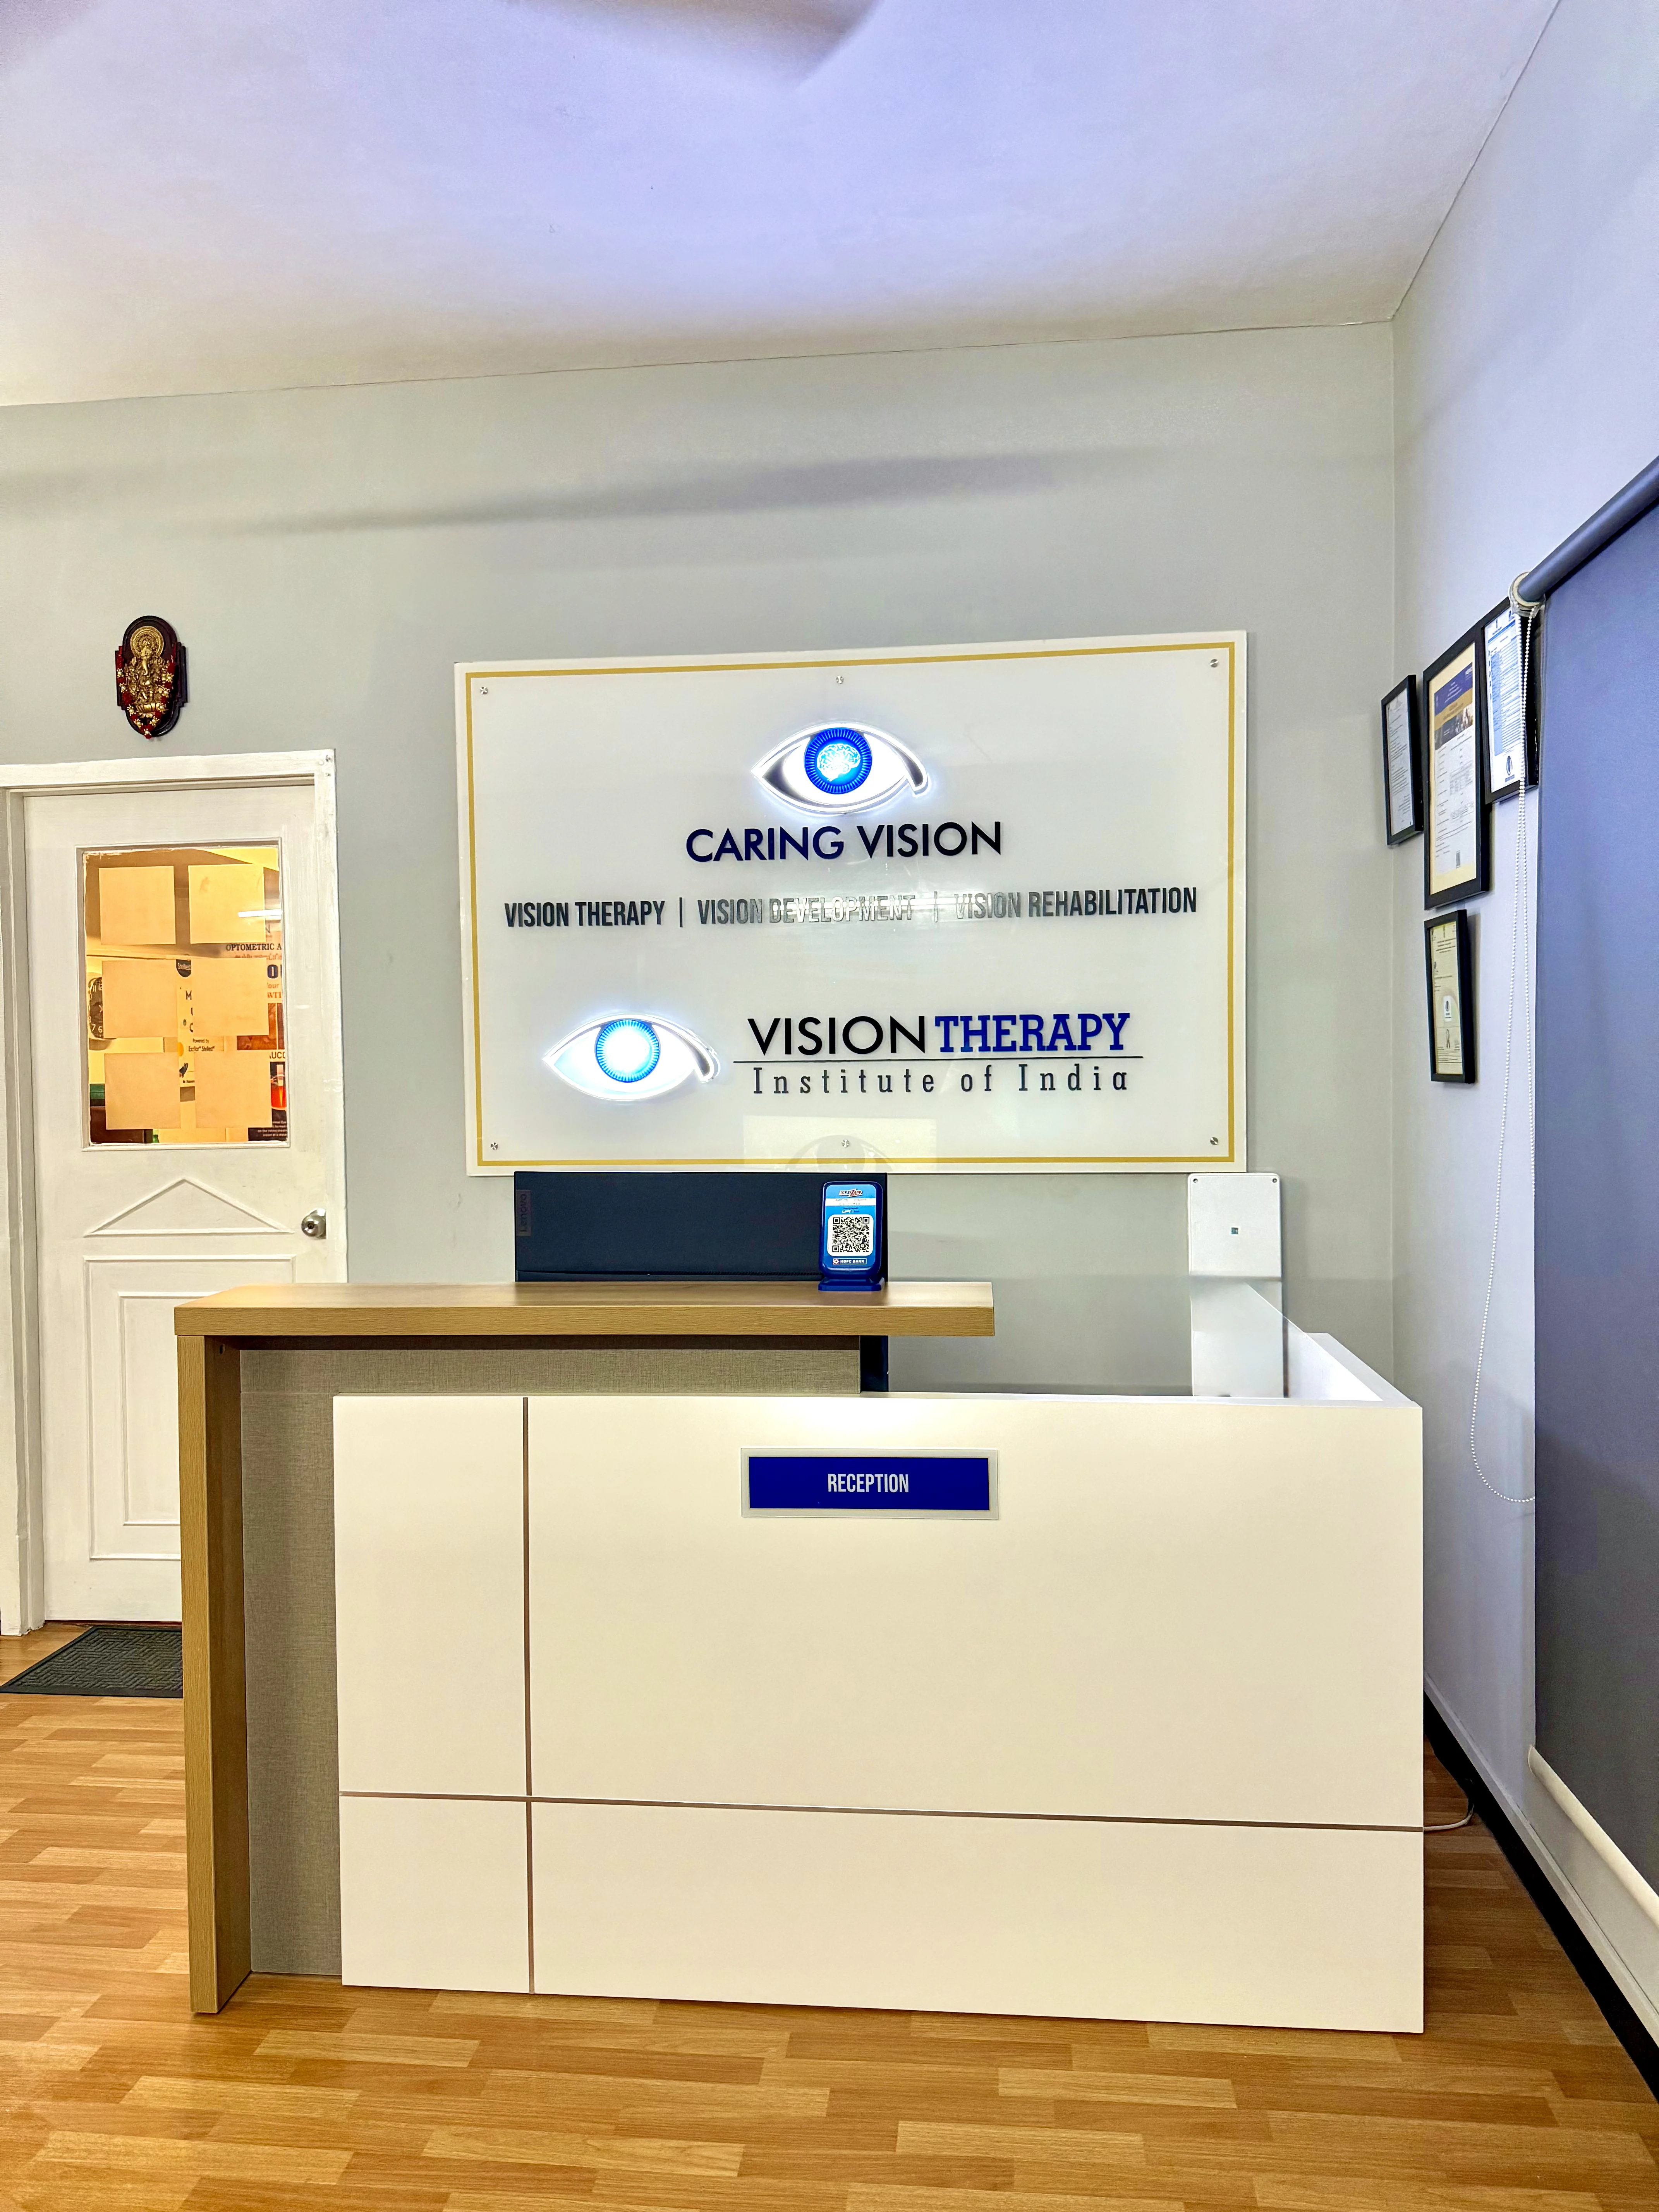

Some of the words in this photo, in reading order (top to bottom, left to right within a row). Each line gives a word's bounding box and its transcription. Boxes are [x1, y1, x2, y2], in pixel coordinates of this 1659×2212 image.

[687, 826, 844, 862] CARING
[857, 821, 1001, 859] VISION
[505, 902, 569, 927] VISION
[575, 901, 665, 926] THERAPY
[697, 898, 763, 924] VISION
[769, 895, 915, 923] DEVELOPMENT
[954, 892, 1021, 919] VISION
[1029, 887, 1196, 917] REHABILITATION
[752, 1067, 934, 1094] Institute
[961, 1065, 992, 1092] of
[1019, 1064, 1127, 1091] India
[828, 1474, 908, 1492] RECEPTION
